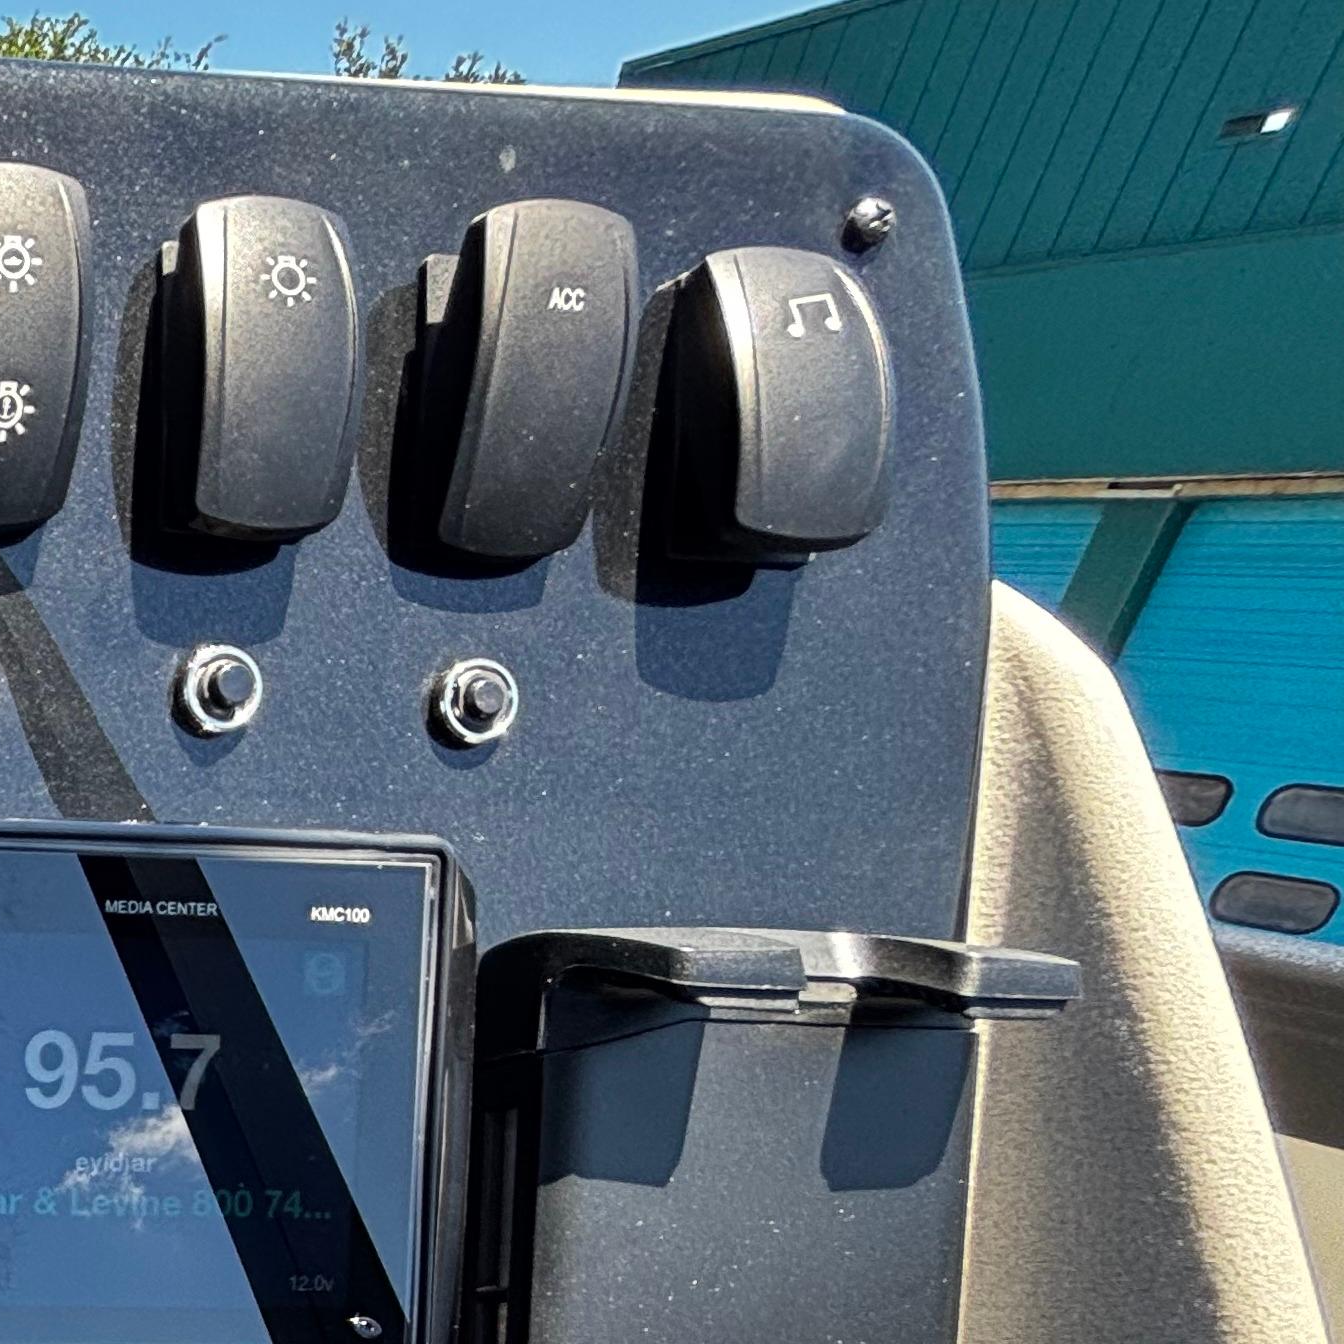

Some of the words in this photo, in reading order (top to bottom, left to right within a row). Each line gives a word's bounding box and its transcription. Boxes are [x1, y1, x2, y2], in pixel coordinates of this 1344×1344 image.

[546, 287, 586, 311] ACC
[105, 900, 152, 915] MEDIA
[156, 901, 218, 917] CENTER
[310, 906, 371, 923] KMC100
[24, 1029, 221, 1111] 95.7
[33, 1186, 57, 1215] &
[191, 1188, 253, 1218] 800
